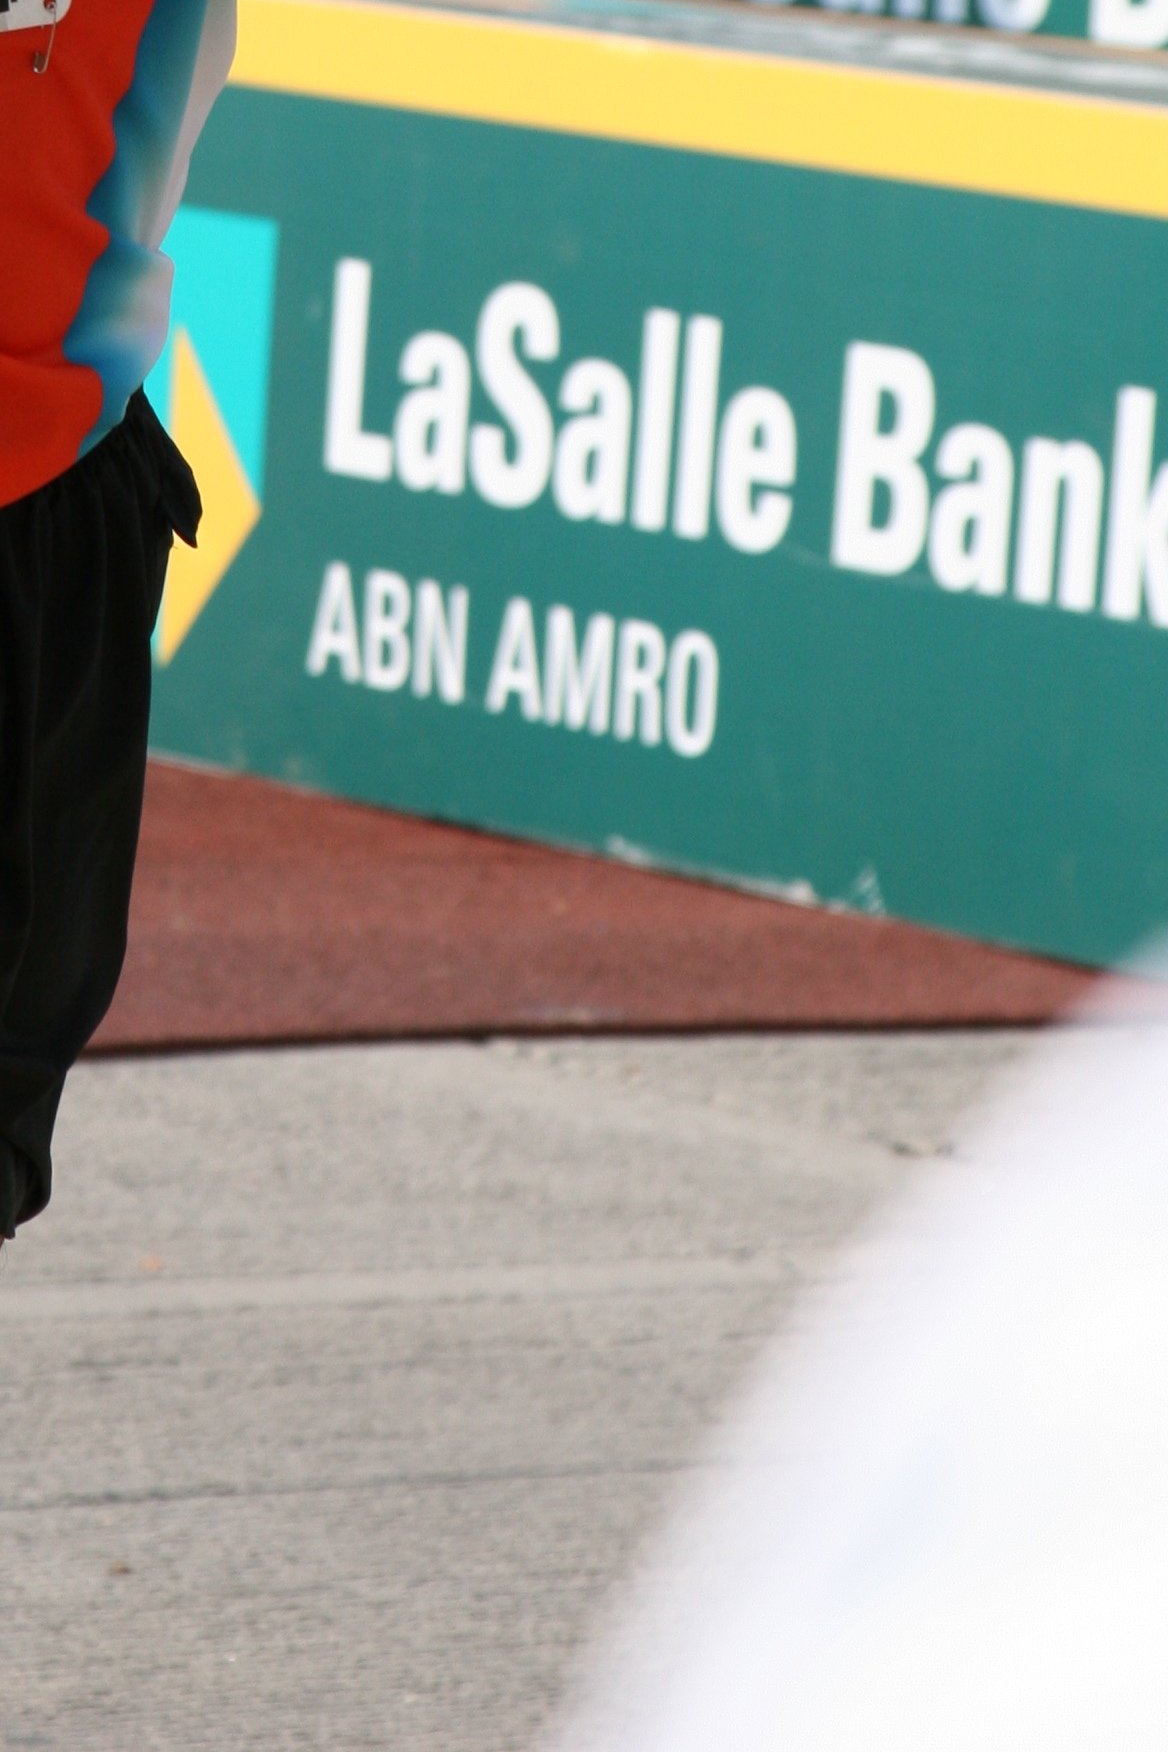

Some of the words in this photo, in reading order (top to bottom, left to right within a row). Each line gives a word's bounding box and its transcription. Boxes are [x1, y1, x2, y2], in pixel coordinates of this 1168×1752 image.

[322, 256, 798, 554] LaSalle
[832, 340, 1168, 630] Bank
[306, 561, 470, 706] ABN
[484, 596, 720, 759] AMRO
